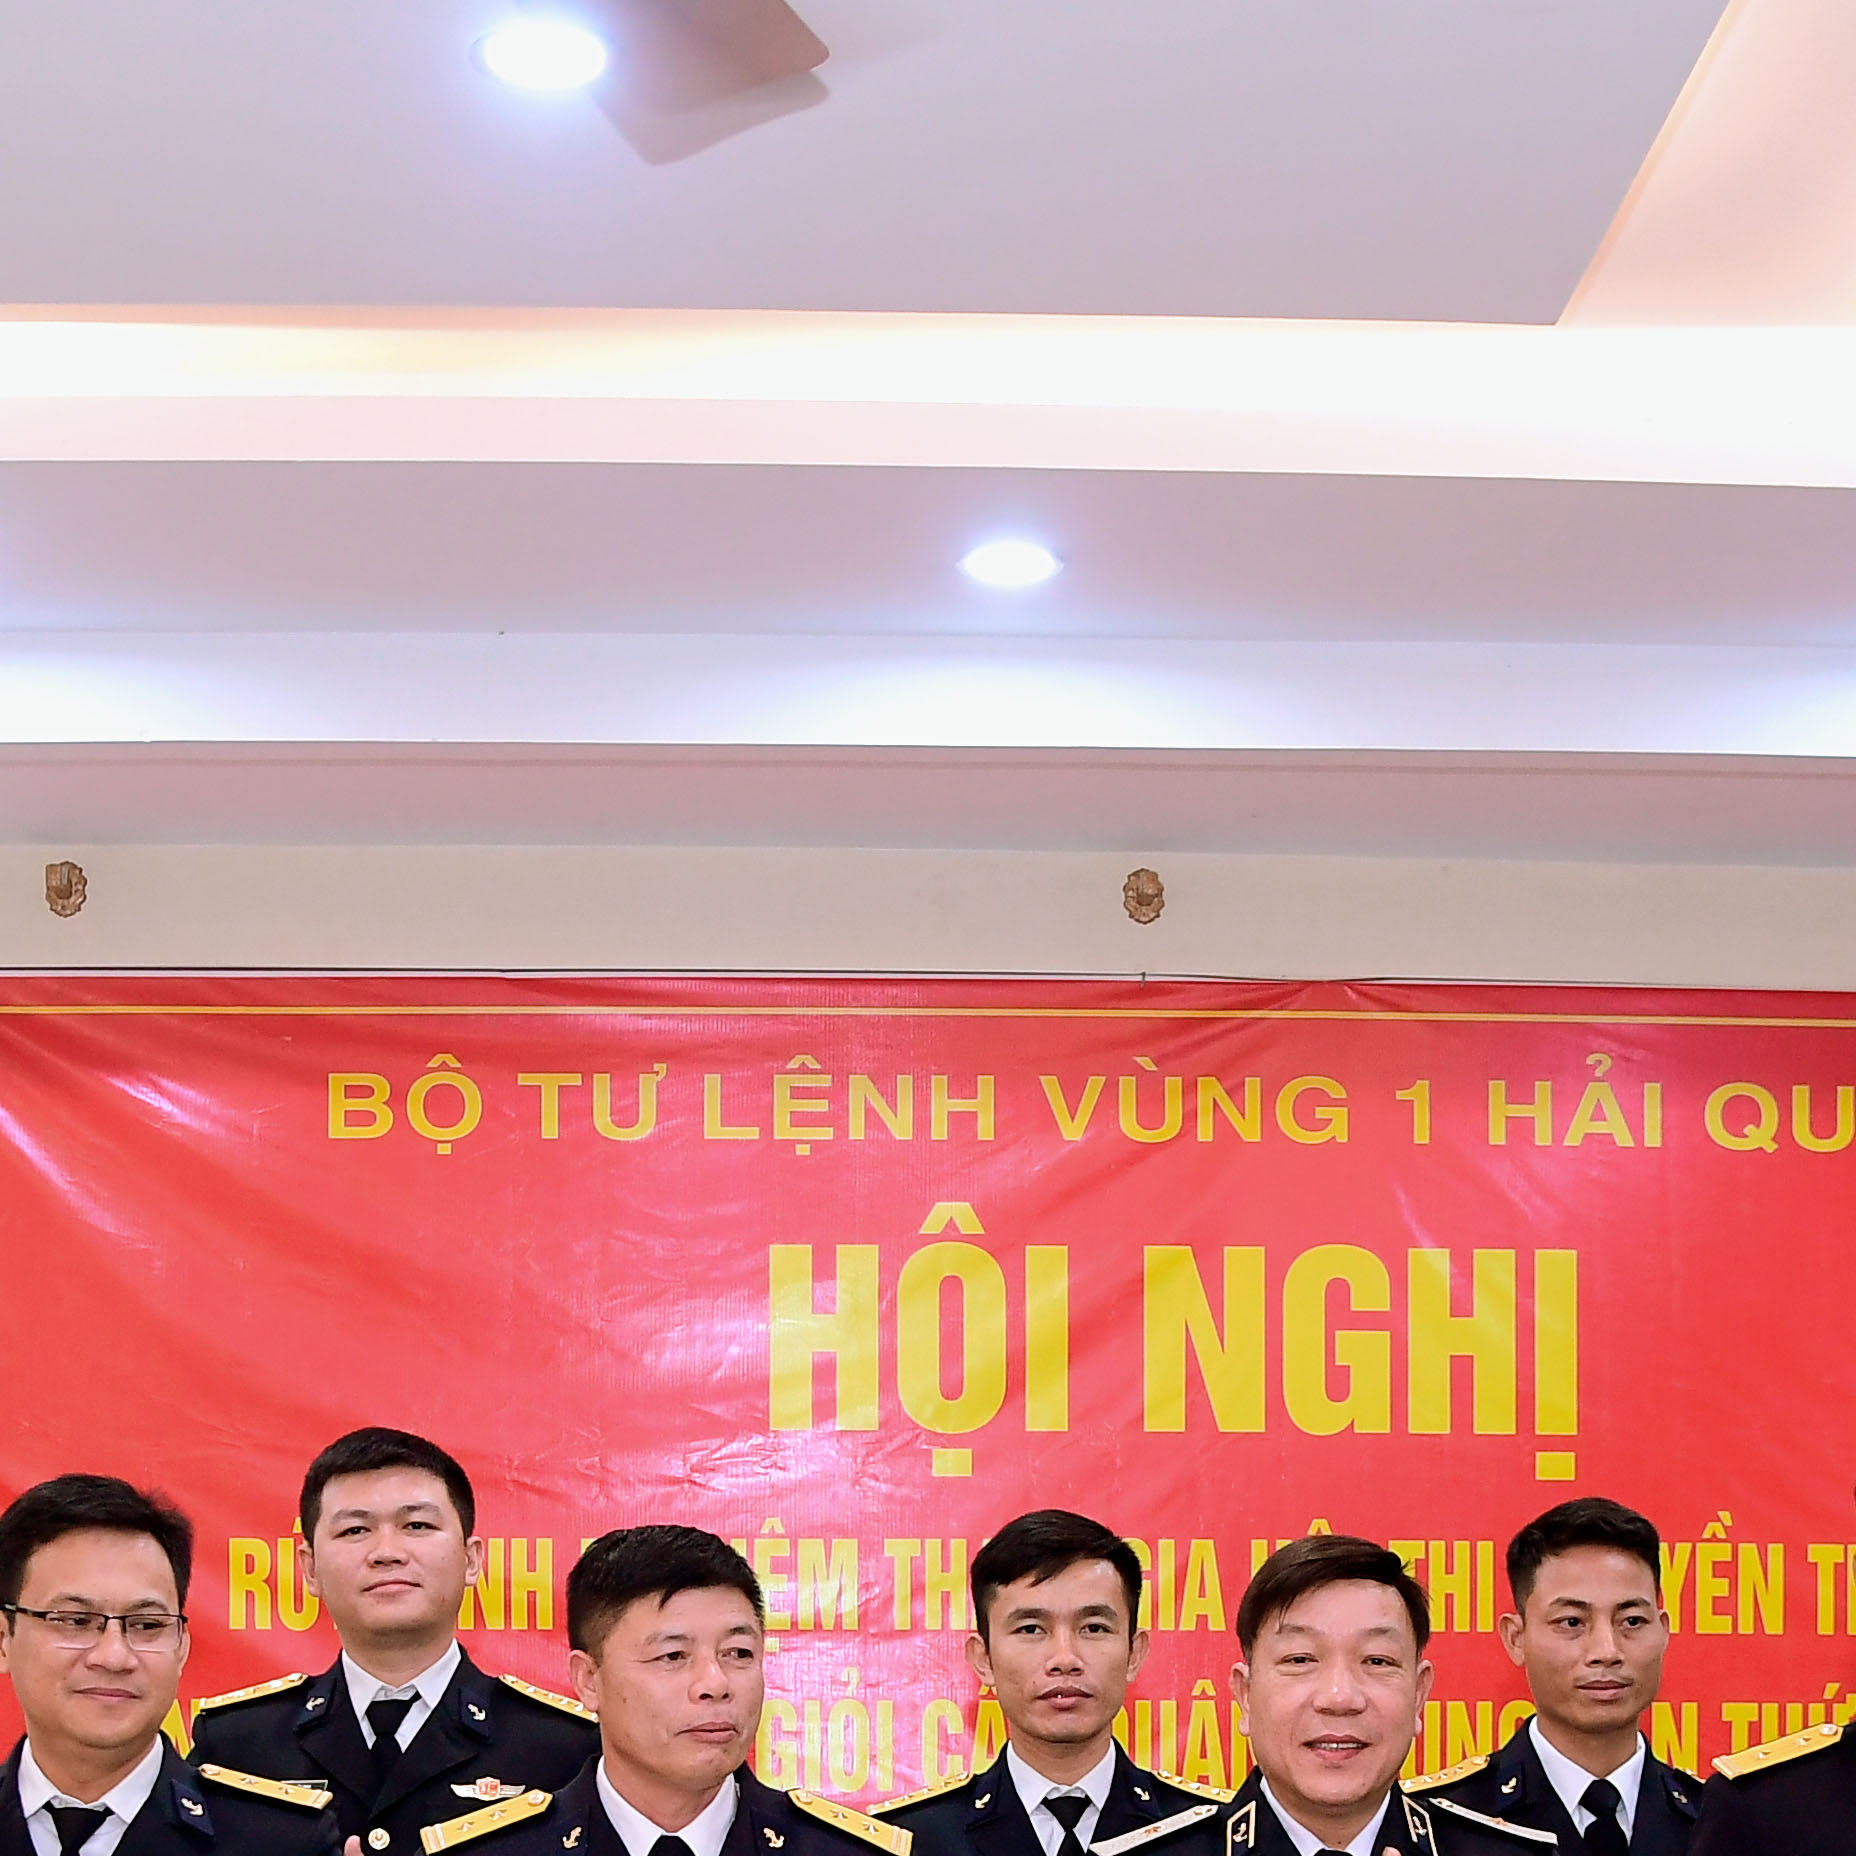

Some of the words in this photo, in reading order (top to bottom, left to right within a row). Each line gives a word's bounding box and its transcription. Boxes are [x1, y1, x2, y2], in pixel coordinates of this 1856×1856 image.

[326, 1053, 484, 1156] BỘ
[517, 1062, 667, 1142] TƯ
[703, 1053, 997, 1156] LỆNH
[1039, 1054, 1350, 1145] VÙNG
[1395, 1078, 1432, 1146] 1
[1487, 1052, 1663, 1149] HẢI
[768, 1201, 1070, 1477] HỘI
[1142, 1242, 1579, 1482] NGHỊ
[755, 1667, 895, 1793] GIỎI
